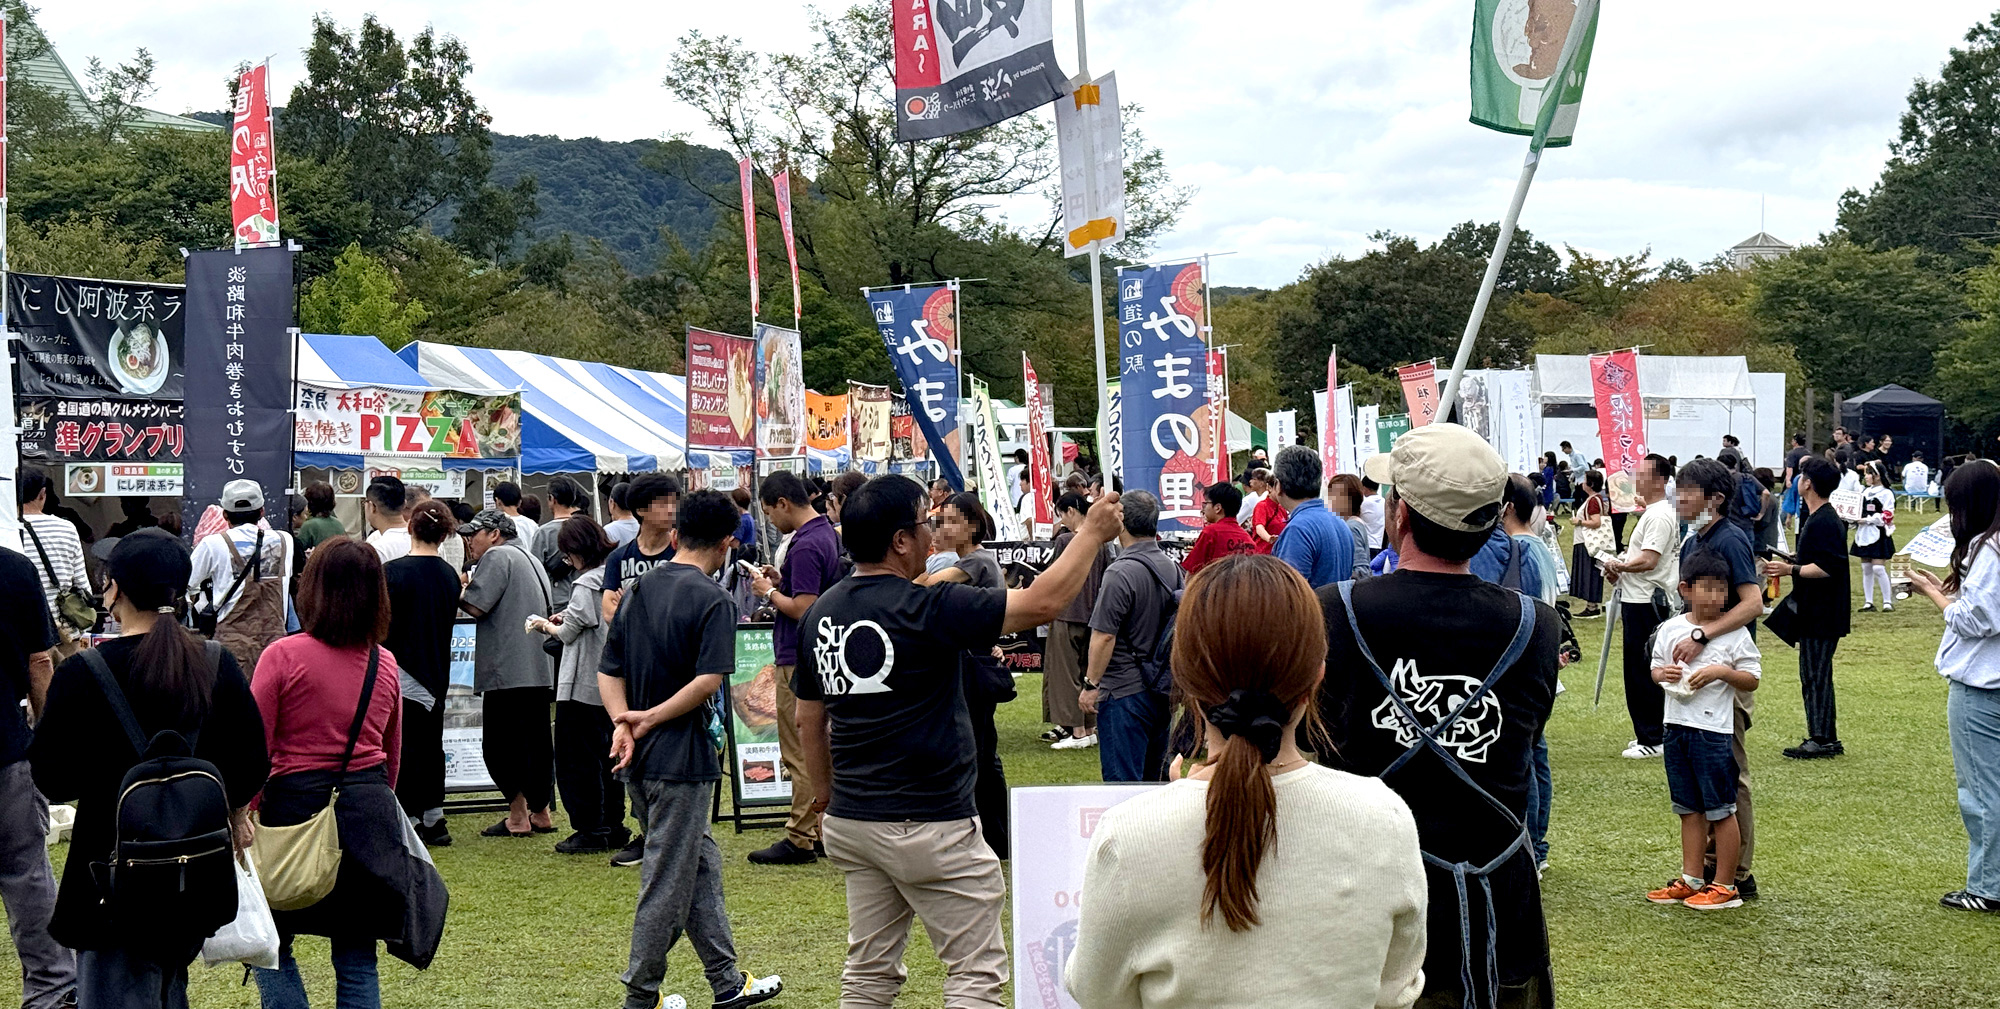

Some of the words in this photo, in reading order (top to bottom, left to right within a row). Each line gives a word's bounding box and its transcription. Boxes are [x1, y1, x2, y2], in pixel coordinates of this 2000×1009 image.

[301, 388, 328, 411] 奈良
[55, 421, 184, 457] 準グランプリ
[295, 418, 353, 447] 窯焼き
[360, 413, 481, 454] PIZZA
